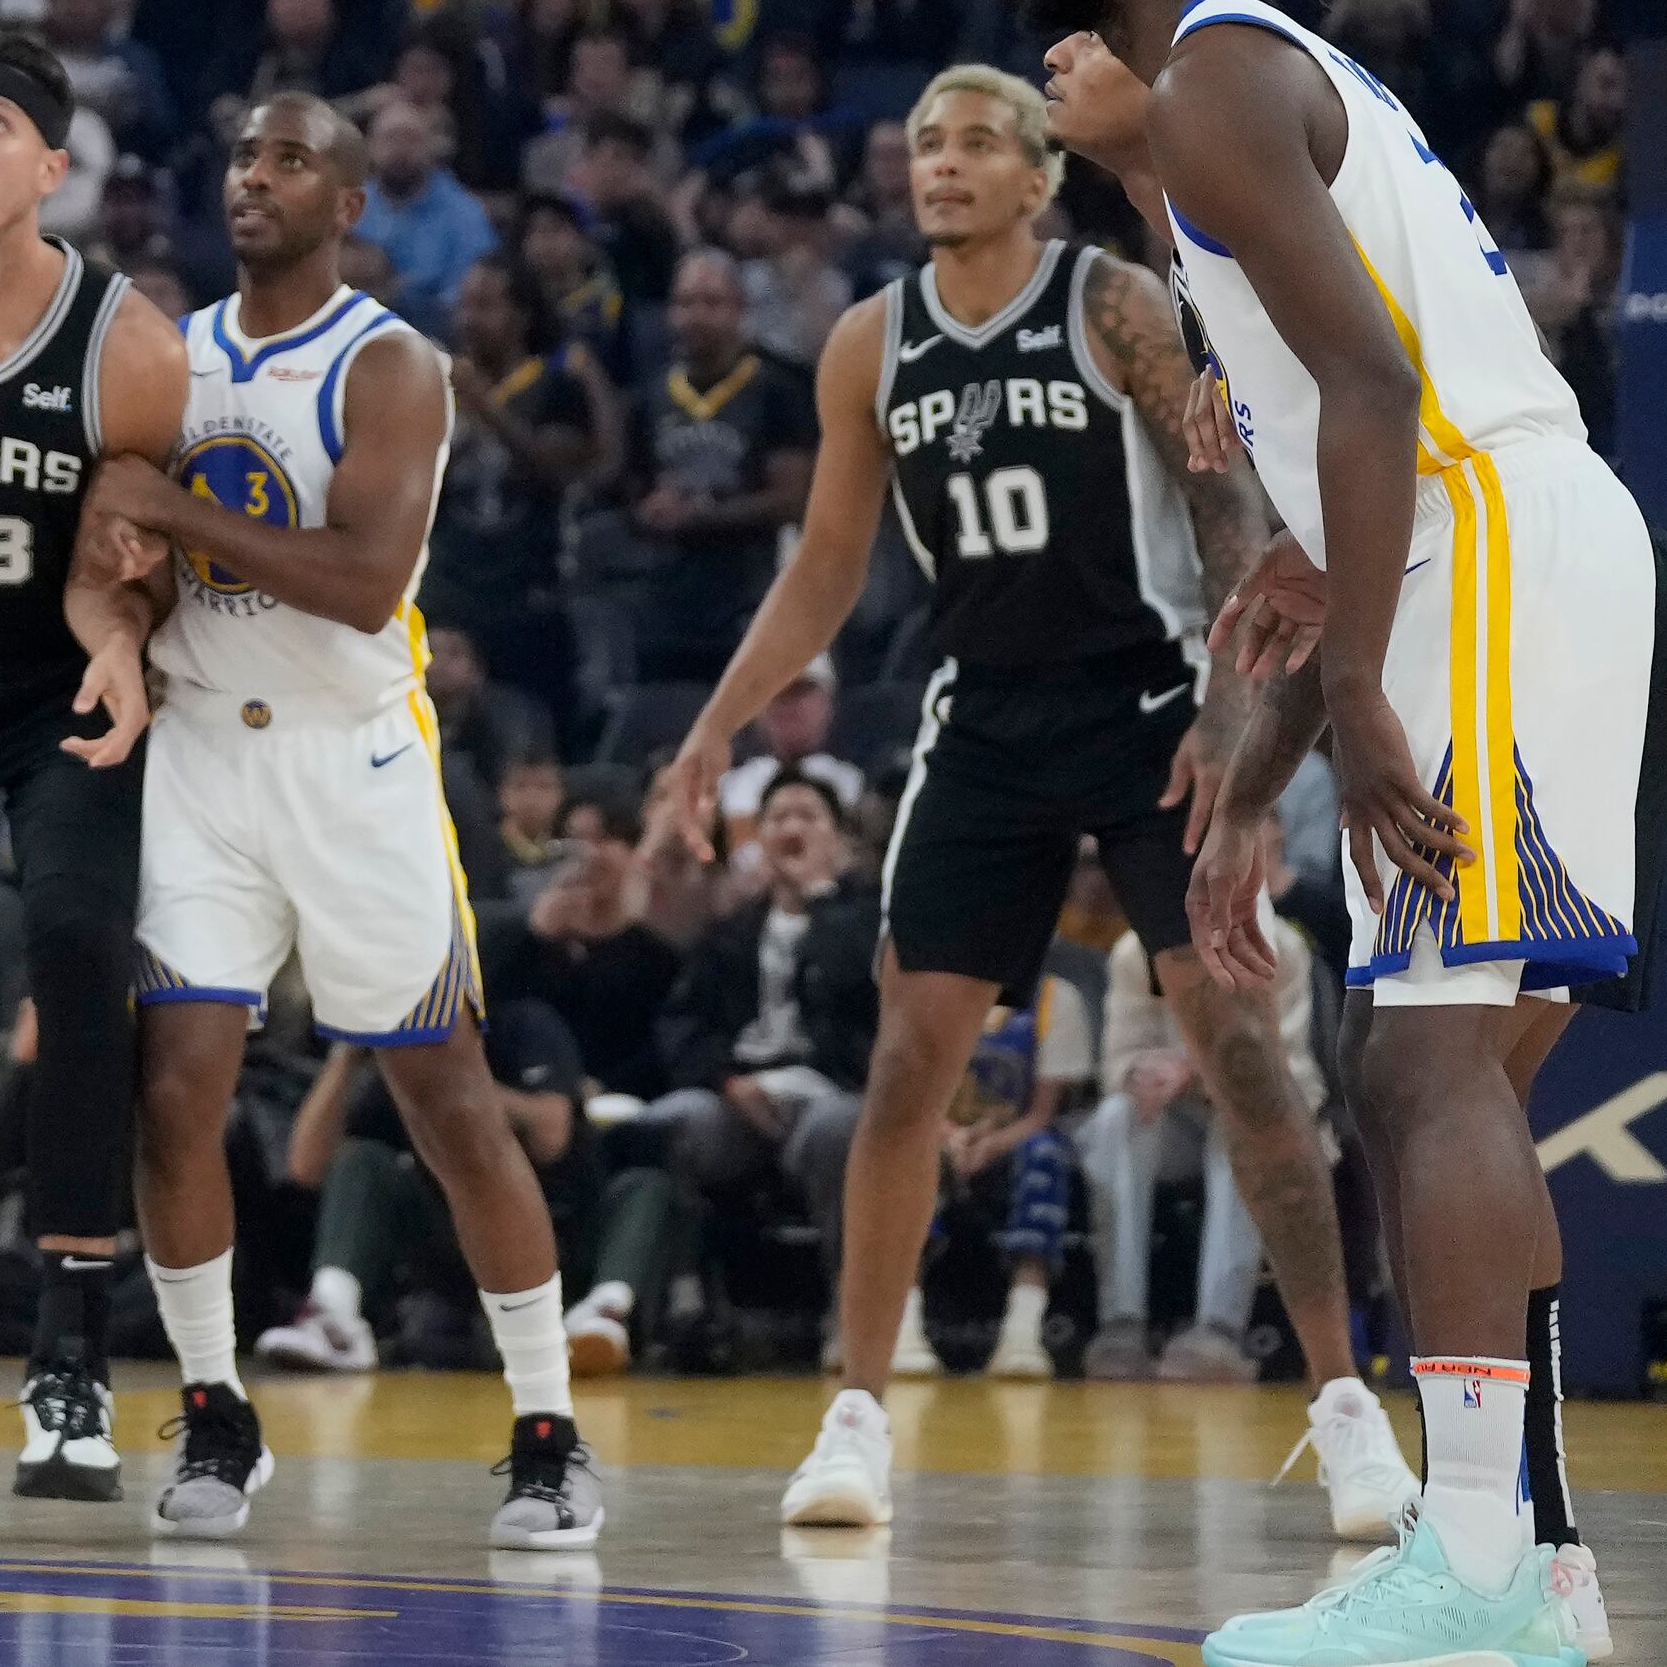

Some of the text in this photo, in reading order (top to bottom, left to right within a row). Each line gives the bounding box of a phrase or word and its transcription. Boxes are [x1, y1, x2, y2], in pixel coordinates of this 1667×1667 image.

[22, 382, 73, 412] Self
[244, 471, 270, 518] 3
[946, 465, 1050, 558] 10
